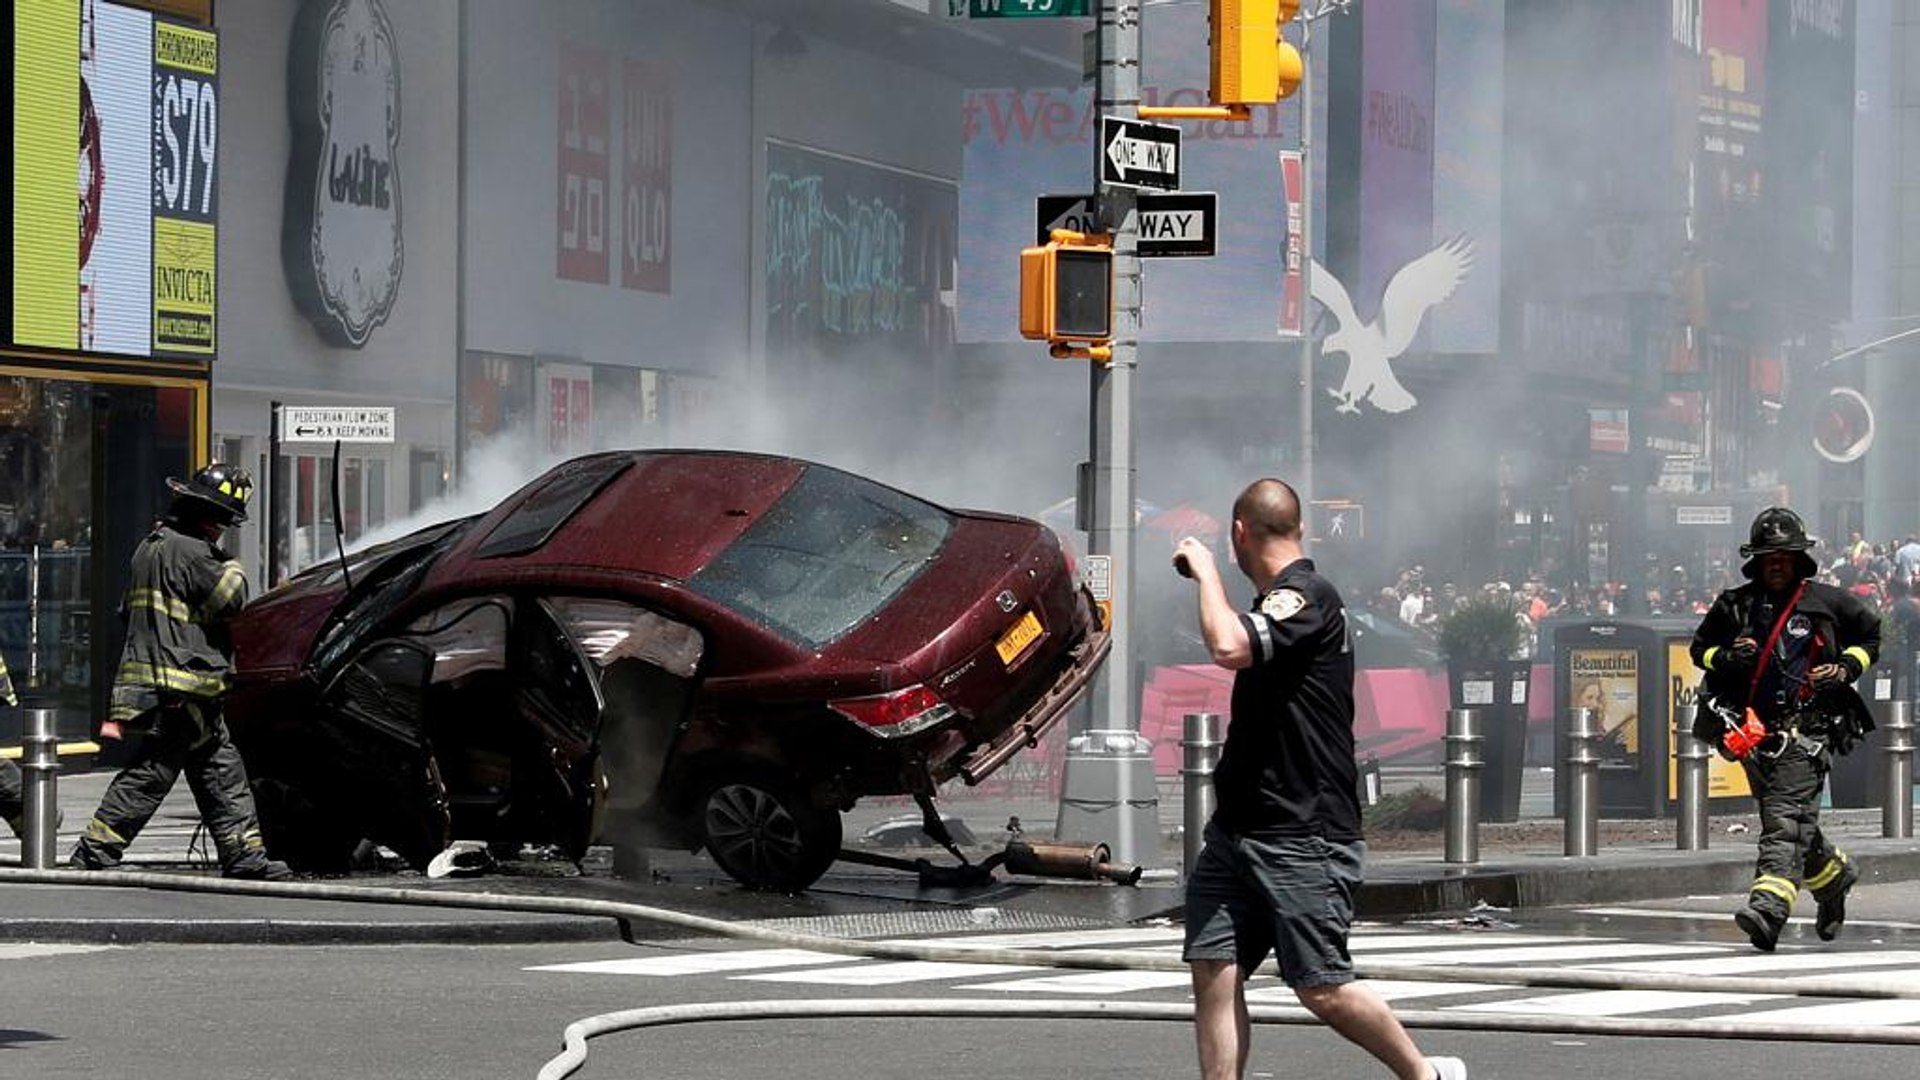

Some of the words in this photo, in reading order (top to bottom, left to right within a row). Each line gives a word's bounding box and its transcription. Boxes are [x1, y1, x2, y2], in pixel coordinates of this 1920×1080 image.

[163, 75, 216, 214] $79
[1115, 139, 1137, 166] ONE
[1147, 144, 1172, 172] WAY
[628, 186, 665, 274] QLO
[1139, 214, 1192, 238] WAY
[157, 266, 212, 303] INVICTA
[294, 412, 343, 423] PEDESTRIAN
[345, 412, 366, 423] FLOW
[369, 412, 389, 423] ZONE
[337, 426, 356, 436] KEEP
[359, 426, 389, 437] MOVING
[941, 660, 976, 687] Accord
[1574, 652, 1636, 671] Beautiful
